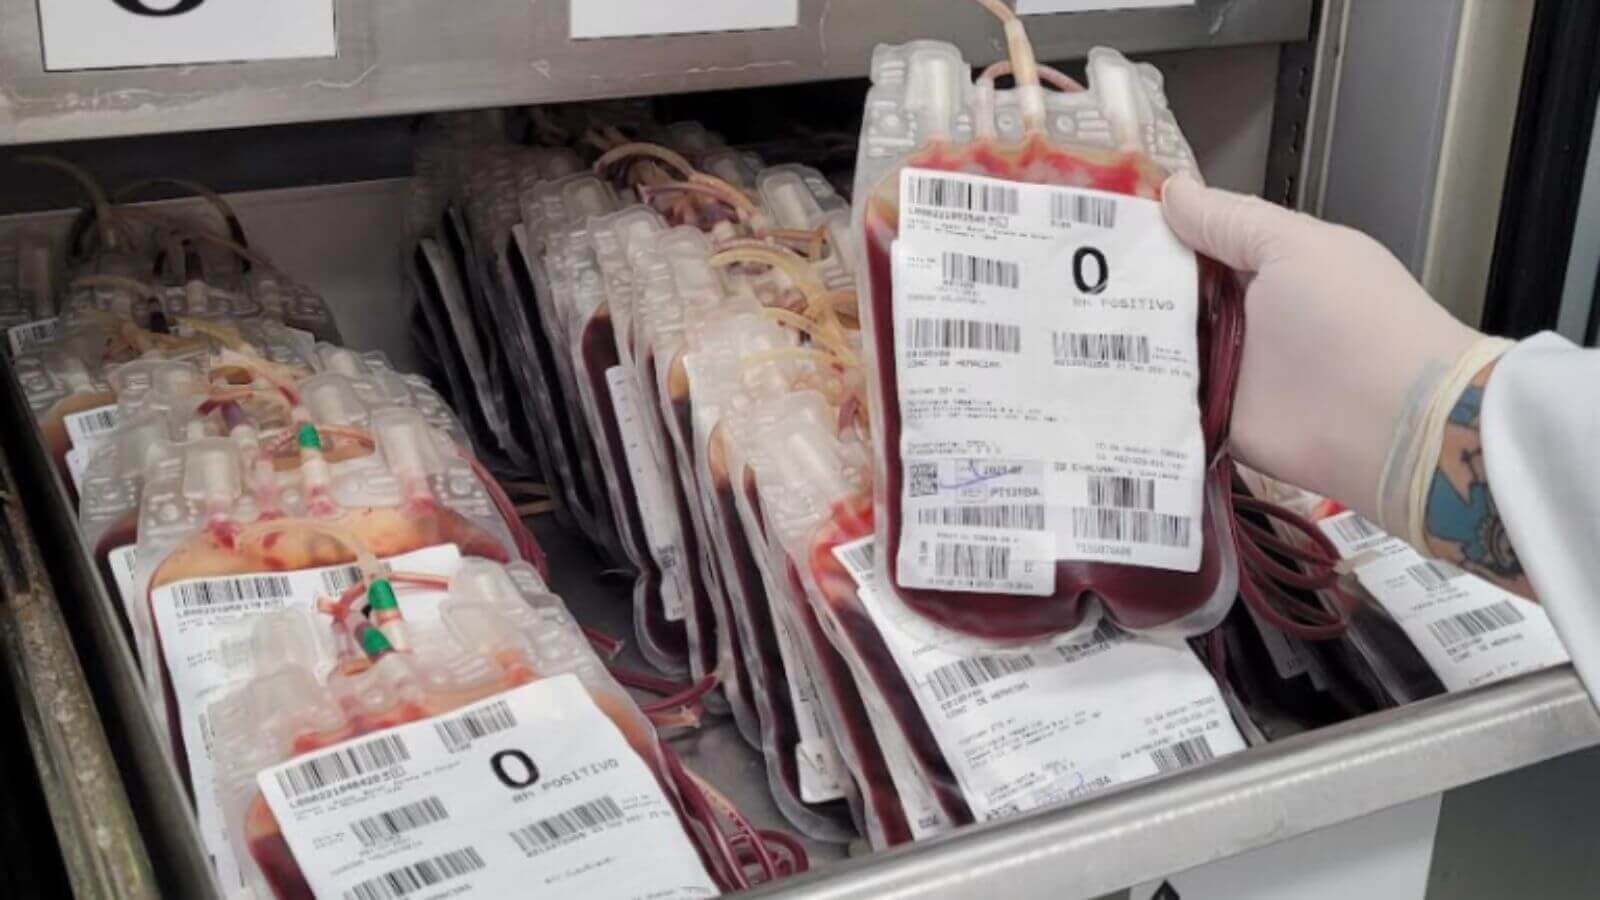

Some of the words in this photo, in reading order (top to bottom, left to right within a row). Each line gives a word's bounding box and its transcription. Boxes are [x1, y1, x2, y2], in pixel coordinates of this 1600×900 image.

[1101, 298, 1175, 311] POSITIVO
[490, 748, 539, 790] O
[541, 758, 619, 791] POSITIVO
